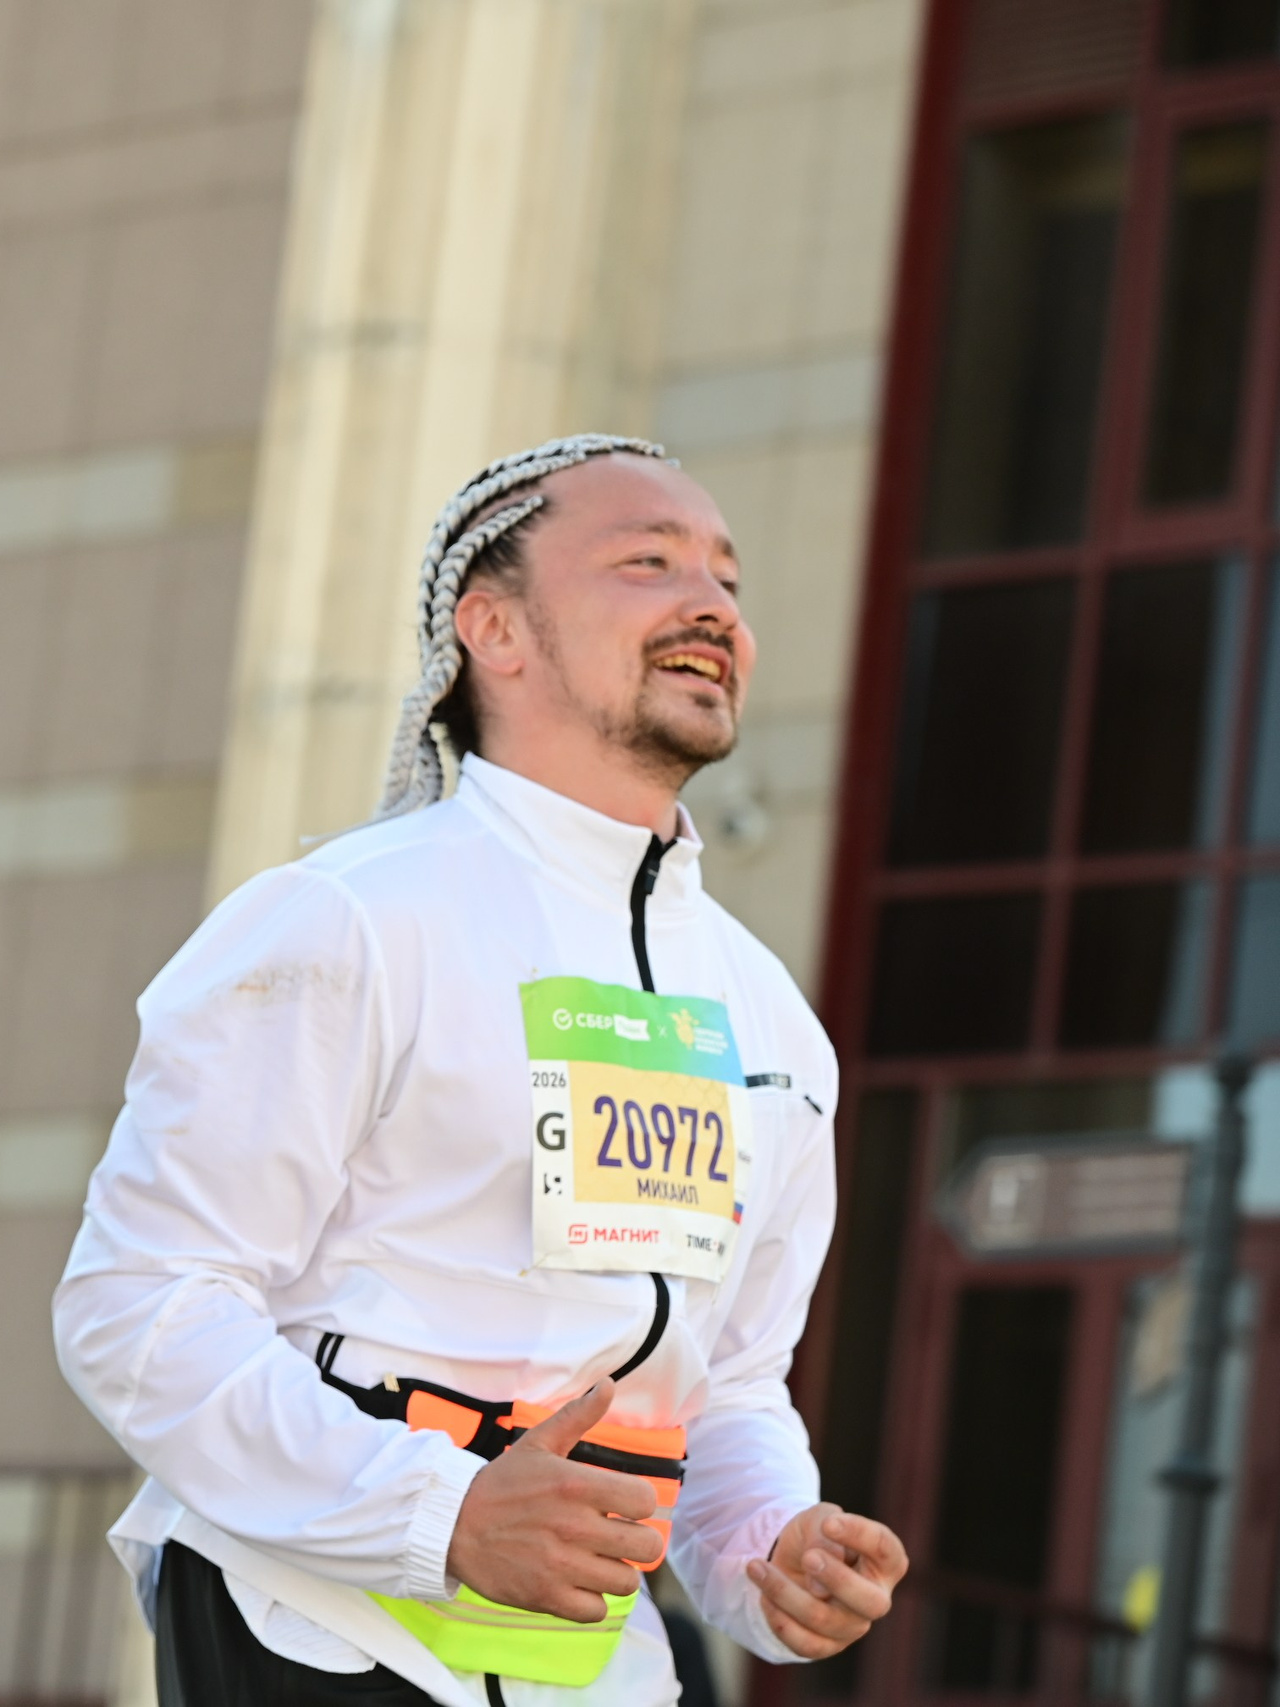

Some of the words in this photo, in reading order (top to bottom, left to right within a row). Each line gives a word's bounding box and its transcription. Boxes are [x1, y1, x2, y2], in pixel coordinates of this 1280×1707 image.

[576, 1012, 614, 1030] СБЕР
[531, 1071, 567, 1088] 2026
[536, 1111, 566, 1151] G
[593, 1095, 729, 1183] 20972
[636, 1177, 700, 1205] МИХАИЛ
[593, 1227, 661, 1244] МАГНИТ
